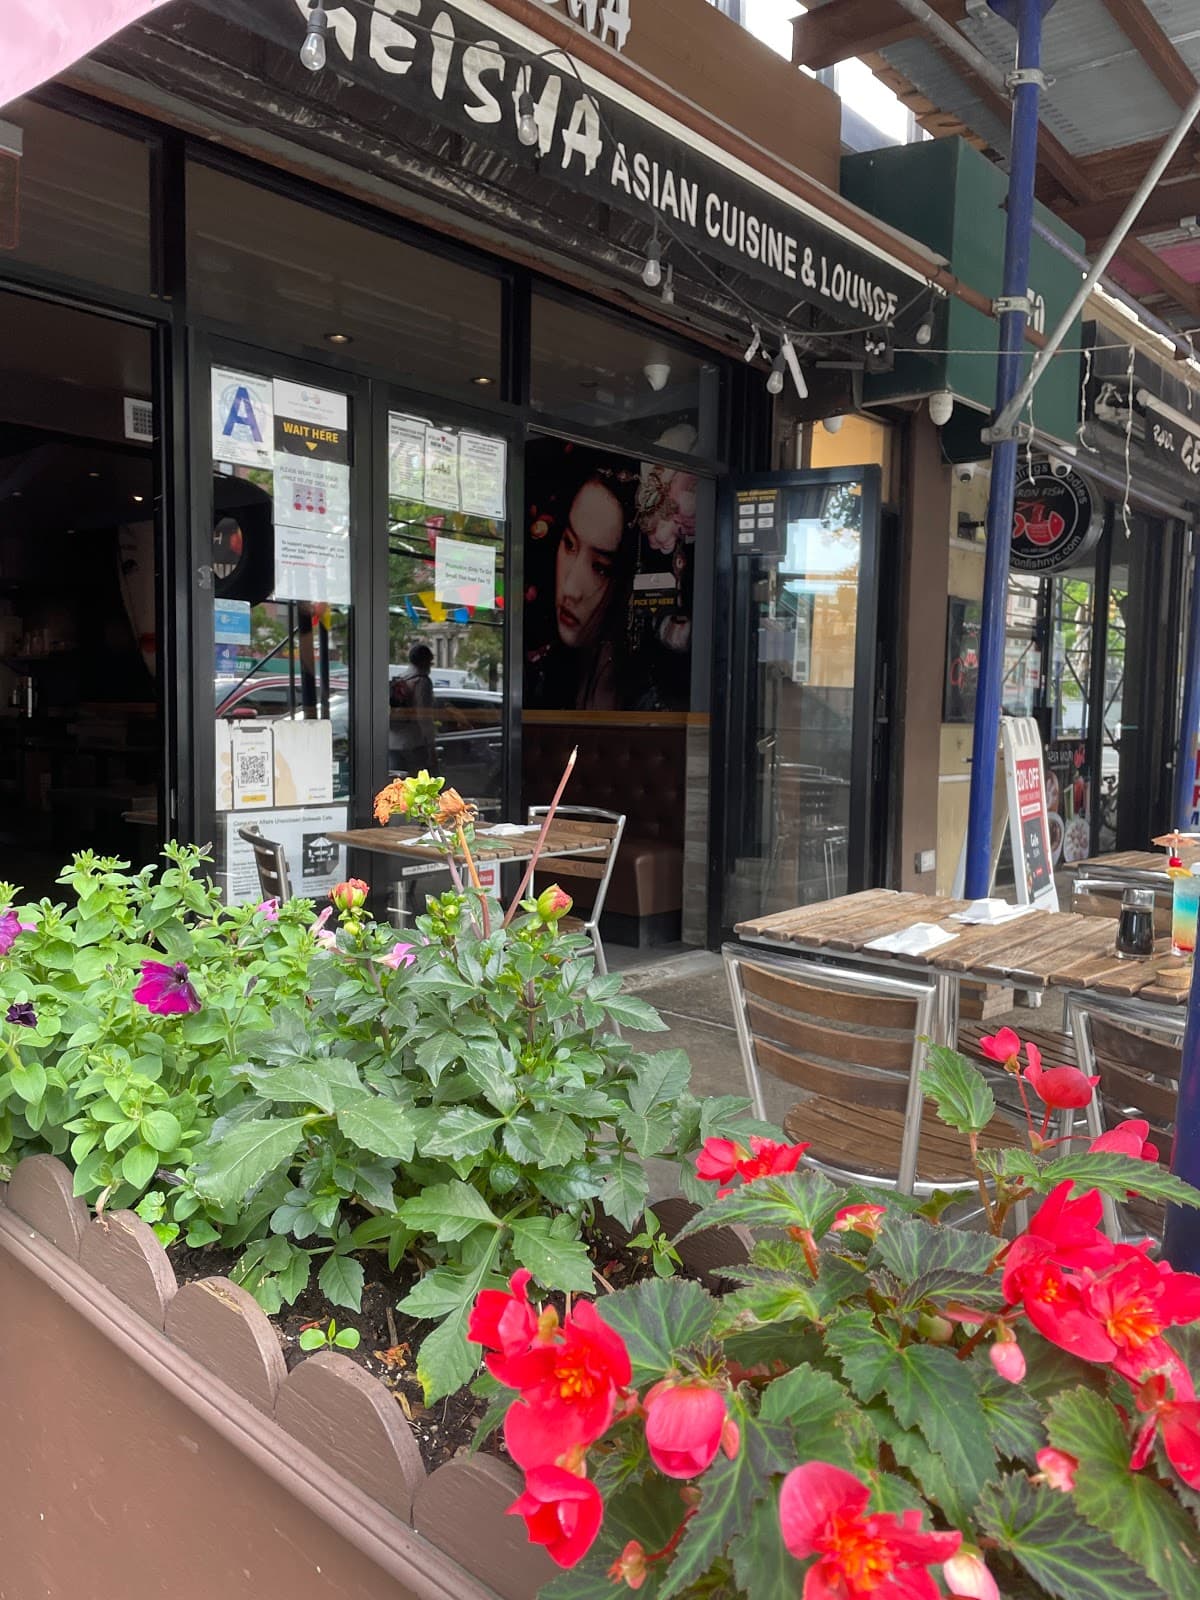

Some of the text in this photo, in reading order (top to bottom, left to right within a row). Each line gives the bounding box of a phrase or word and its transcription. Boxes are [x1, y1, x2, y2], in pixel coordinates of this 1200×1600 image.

[611, 143, 898, 327] ASIAN CUISINE & LOUNGE
[222, 386, 264, 443] A
[283, 422, 339, 443] WAIT HERE
[1011, 535, 1081, 569] ronfishnyc.com
[1028, 767, 1040, 789] OFF
